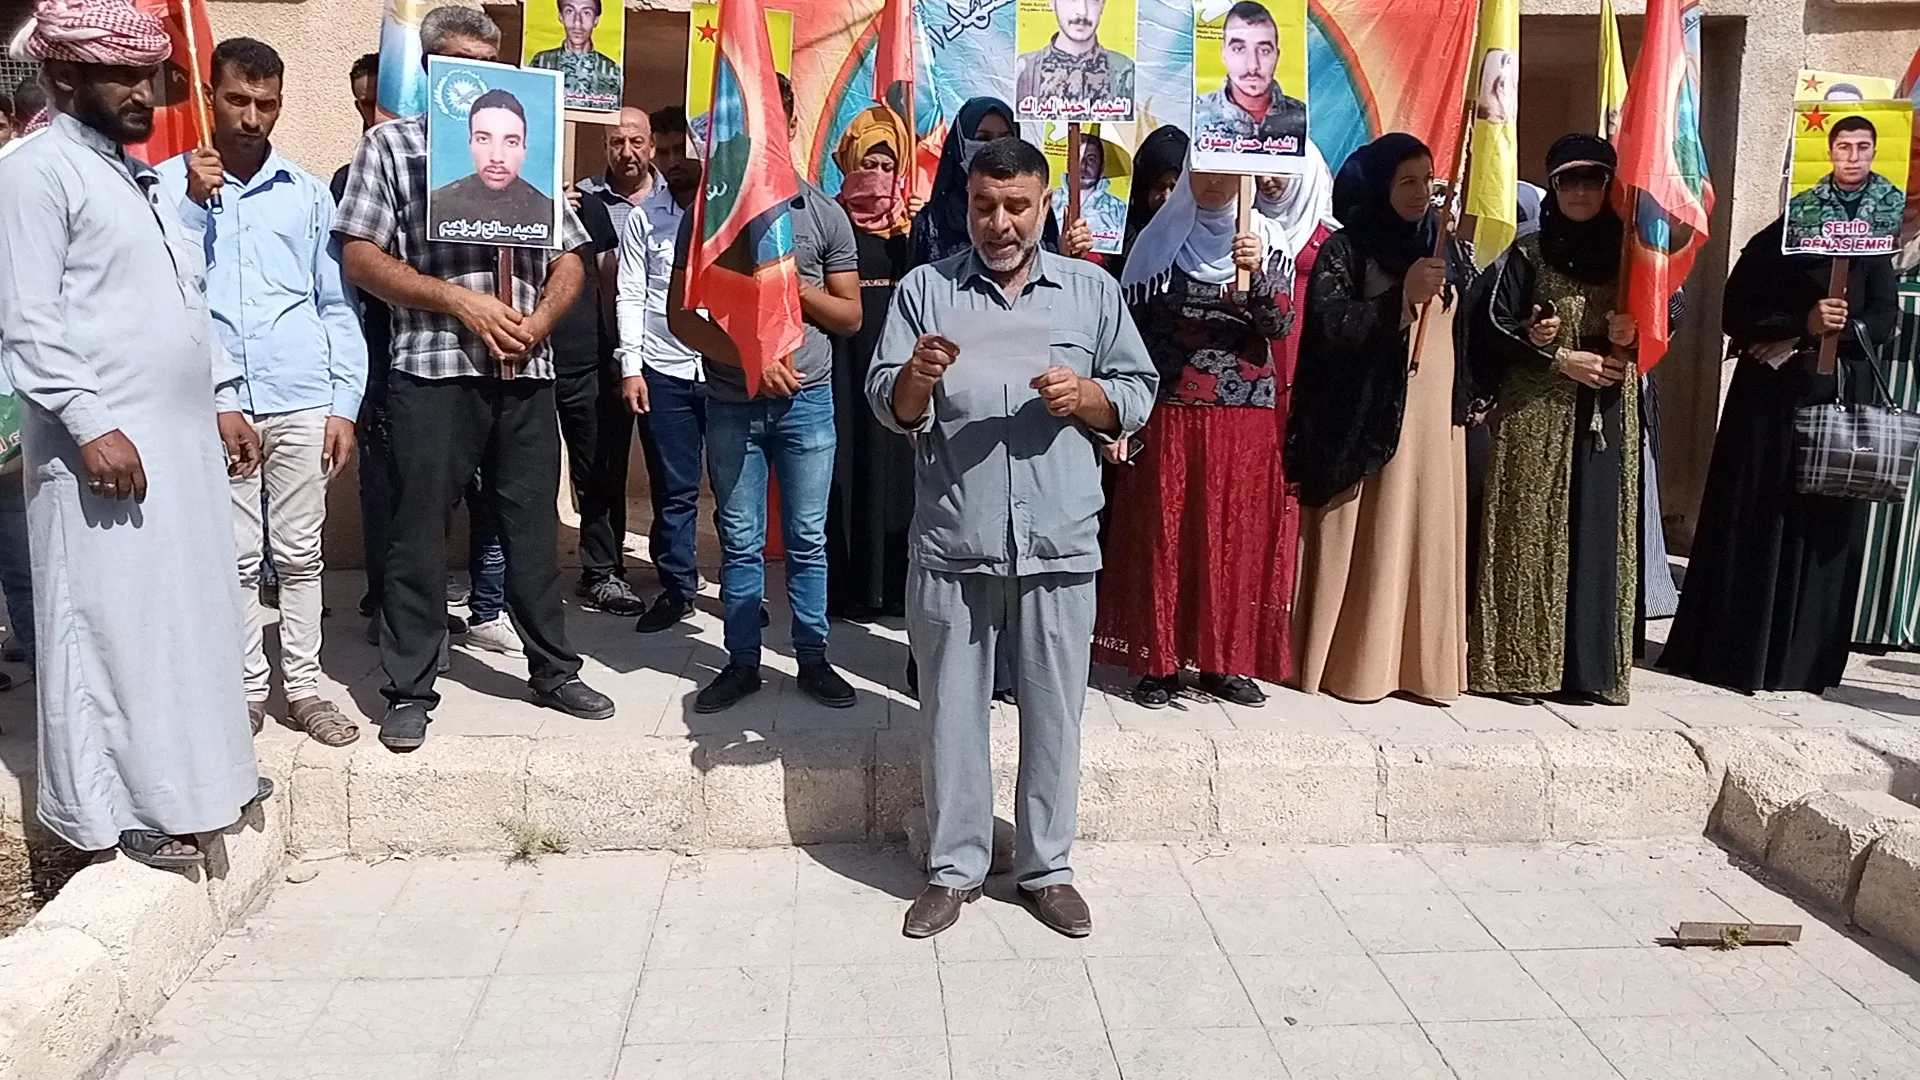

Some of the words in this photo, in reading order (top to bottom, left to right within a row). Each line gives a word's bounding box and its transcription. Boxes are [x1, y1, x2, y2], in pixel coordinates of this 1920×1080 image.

[588, 92, 618, 103] الشهيد
[1019, 95, 1058, 117] البراك
[1060, 97, 1090, 113] احمد
[1091, 97, 1131, 117] الشهيد
[1199, 131, 1234, 152] صفوق
[1234, 134, 1262, 154] حسن
[1263, 135, 1298, 155] الشهيد
[439, 218, 481, 238] ابراهيم
[482, 220, 512, 240] صالح
[512, 223, 548, 241] الشهيد
[1091, 230, 1120, 241] الشهيد
